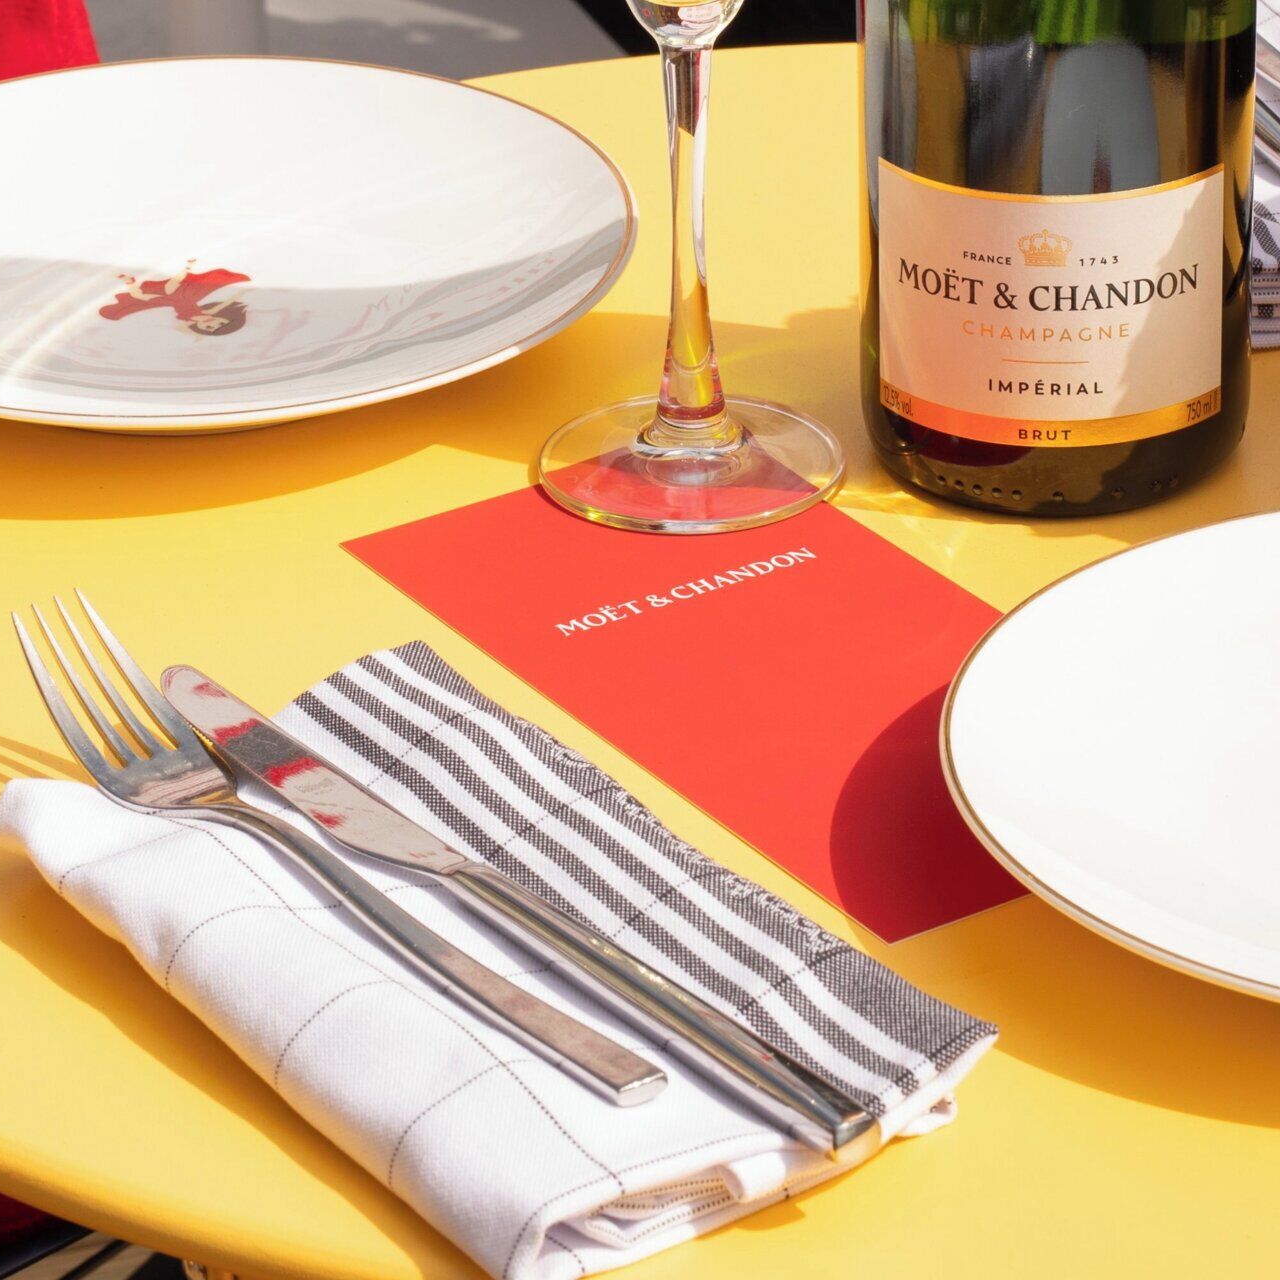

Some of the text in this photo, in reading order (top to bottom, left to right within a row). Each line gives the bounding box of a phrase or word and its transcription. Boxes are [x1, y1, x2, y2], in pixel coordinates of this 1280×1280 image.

[962, 250, 1120, 267] FRANCE 1743
[898, 257, 1200, 312] MOËT & CHANDON
[961, 320, 1131, 343] CHAMPAGNE
[987, 378, 1104, 396] IMPÉRIAL
[1187, 400, 1202, 422] 750
[1017, 428, 1072, 441] BRUT
[555, 546, 817, 637] MOËT & CHANDON
